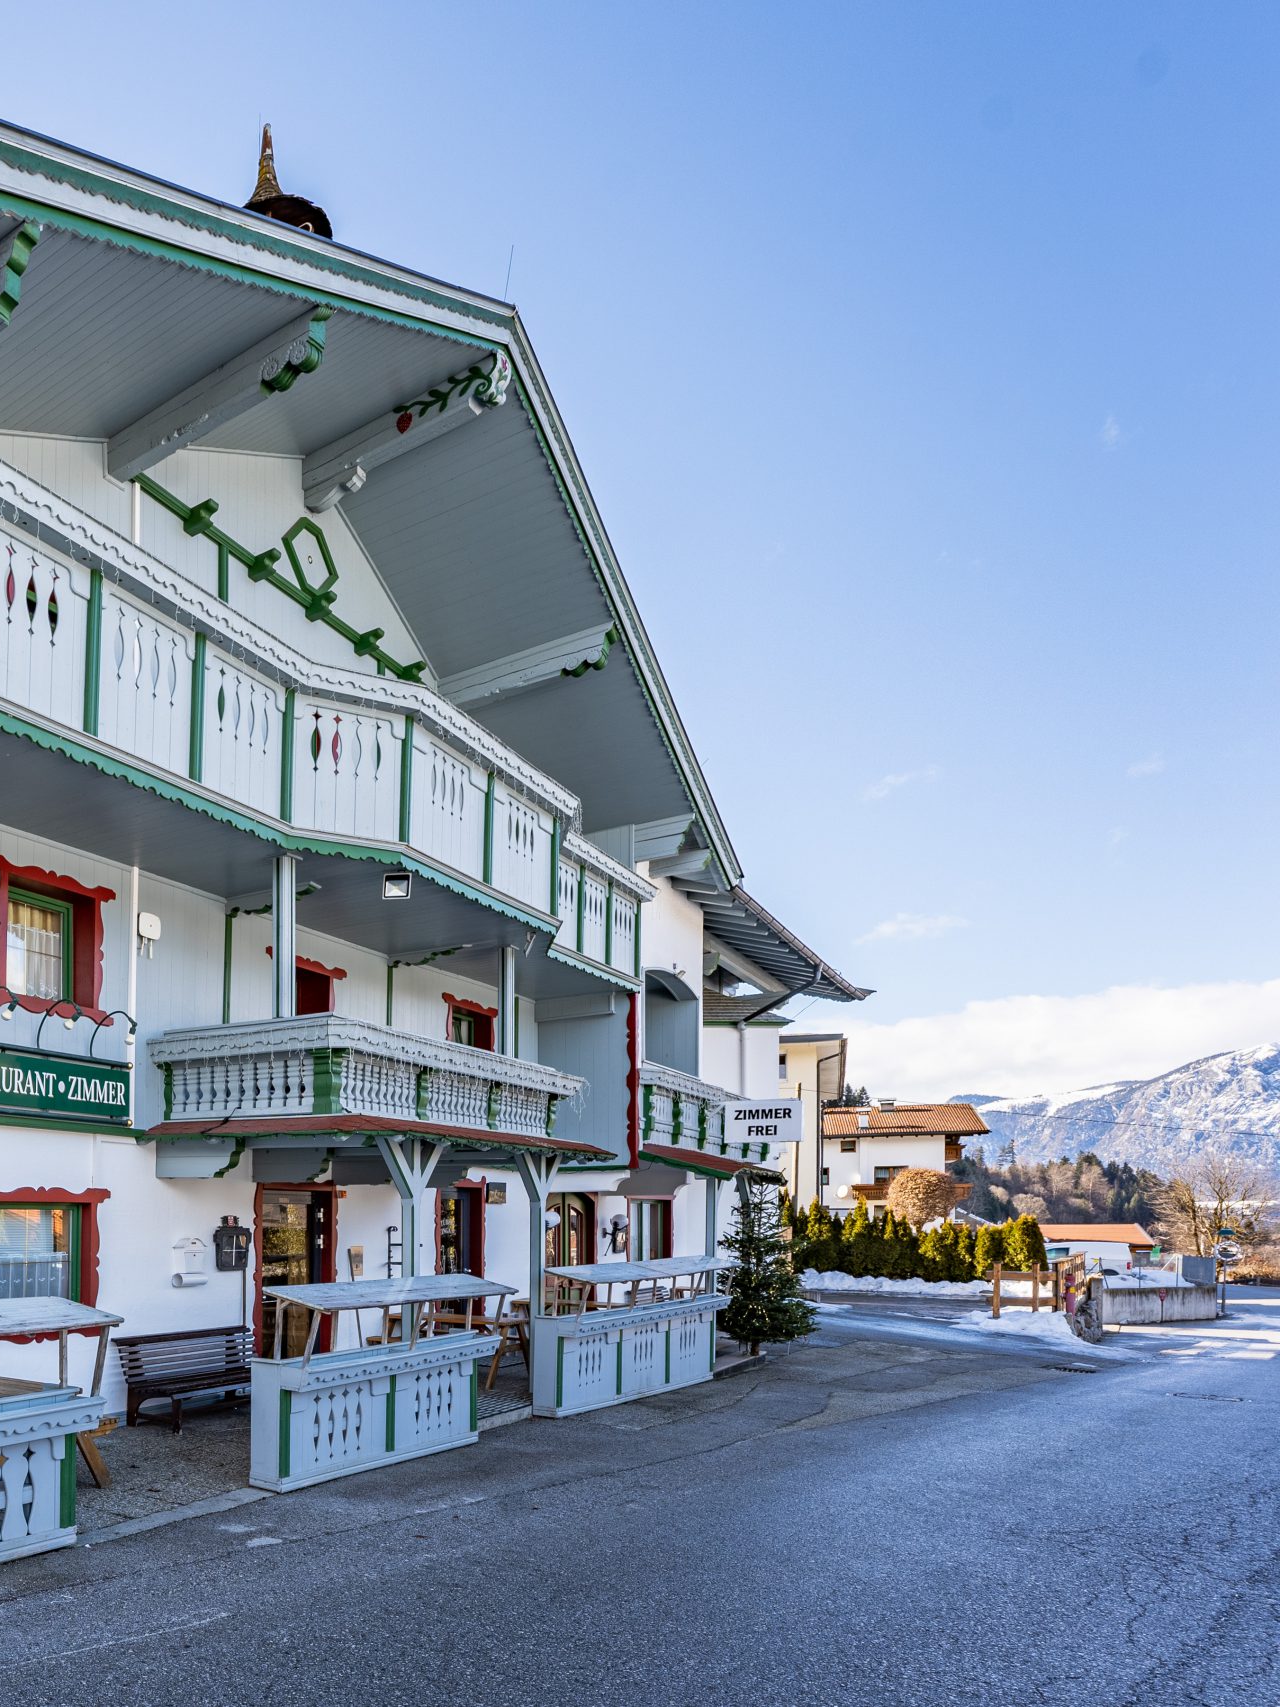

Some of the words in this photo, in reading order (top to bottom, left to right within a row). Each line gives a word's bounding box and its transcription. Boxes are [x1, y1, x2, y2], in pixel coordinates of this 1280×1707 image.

[67, 1076, 126, 1106] ZIMMER
[734, 1108, 792, 1120] ZIMMER
[747, 1125, 778, 1136] FREI
